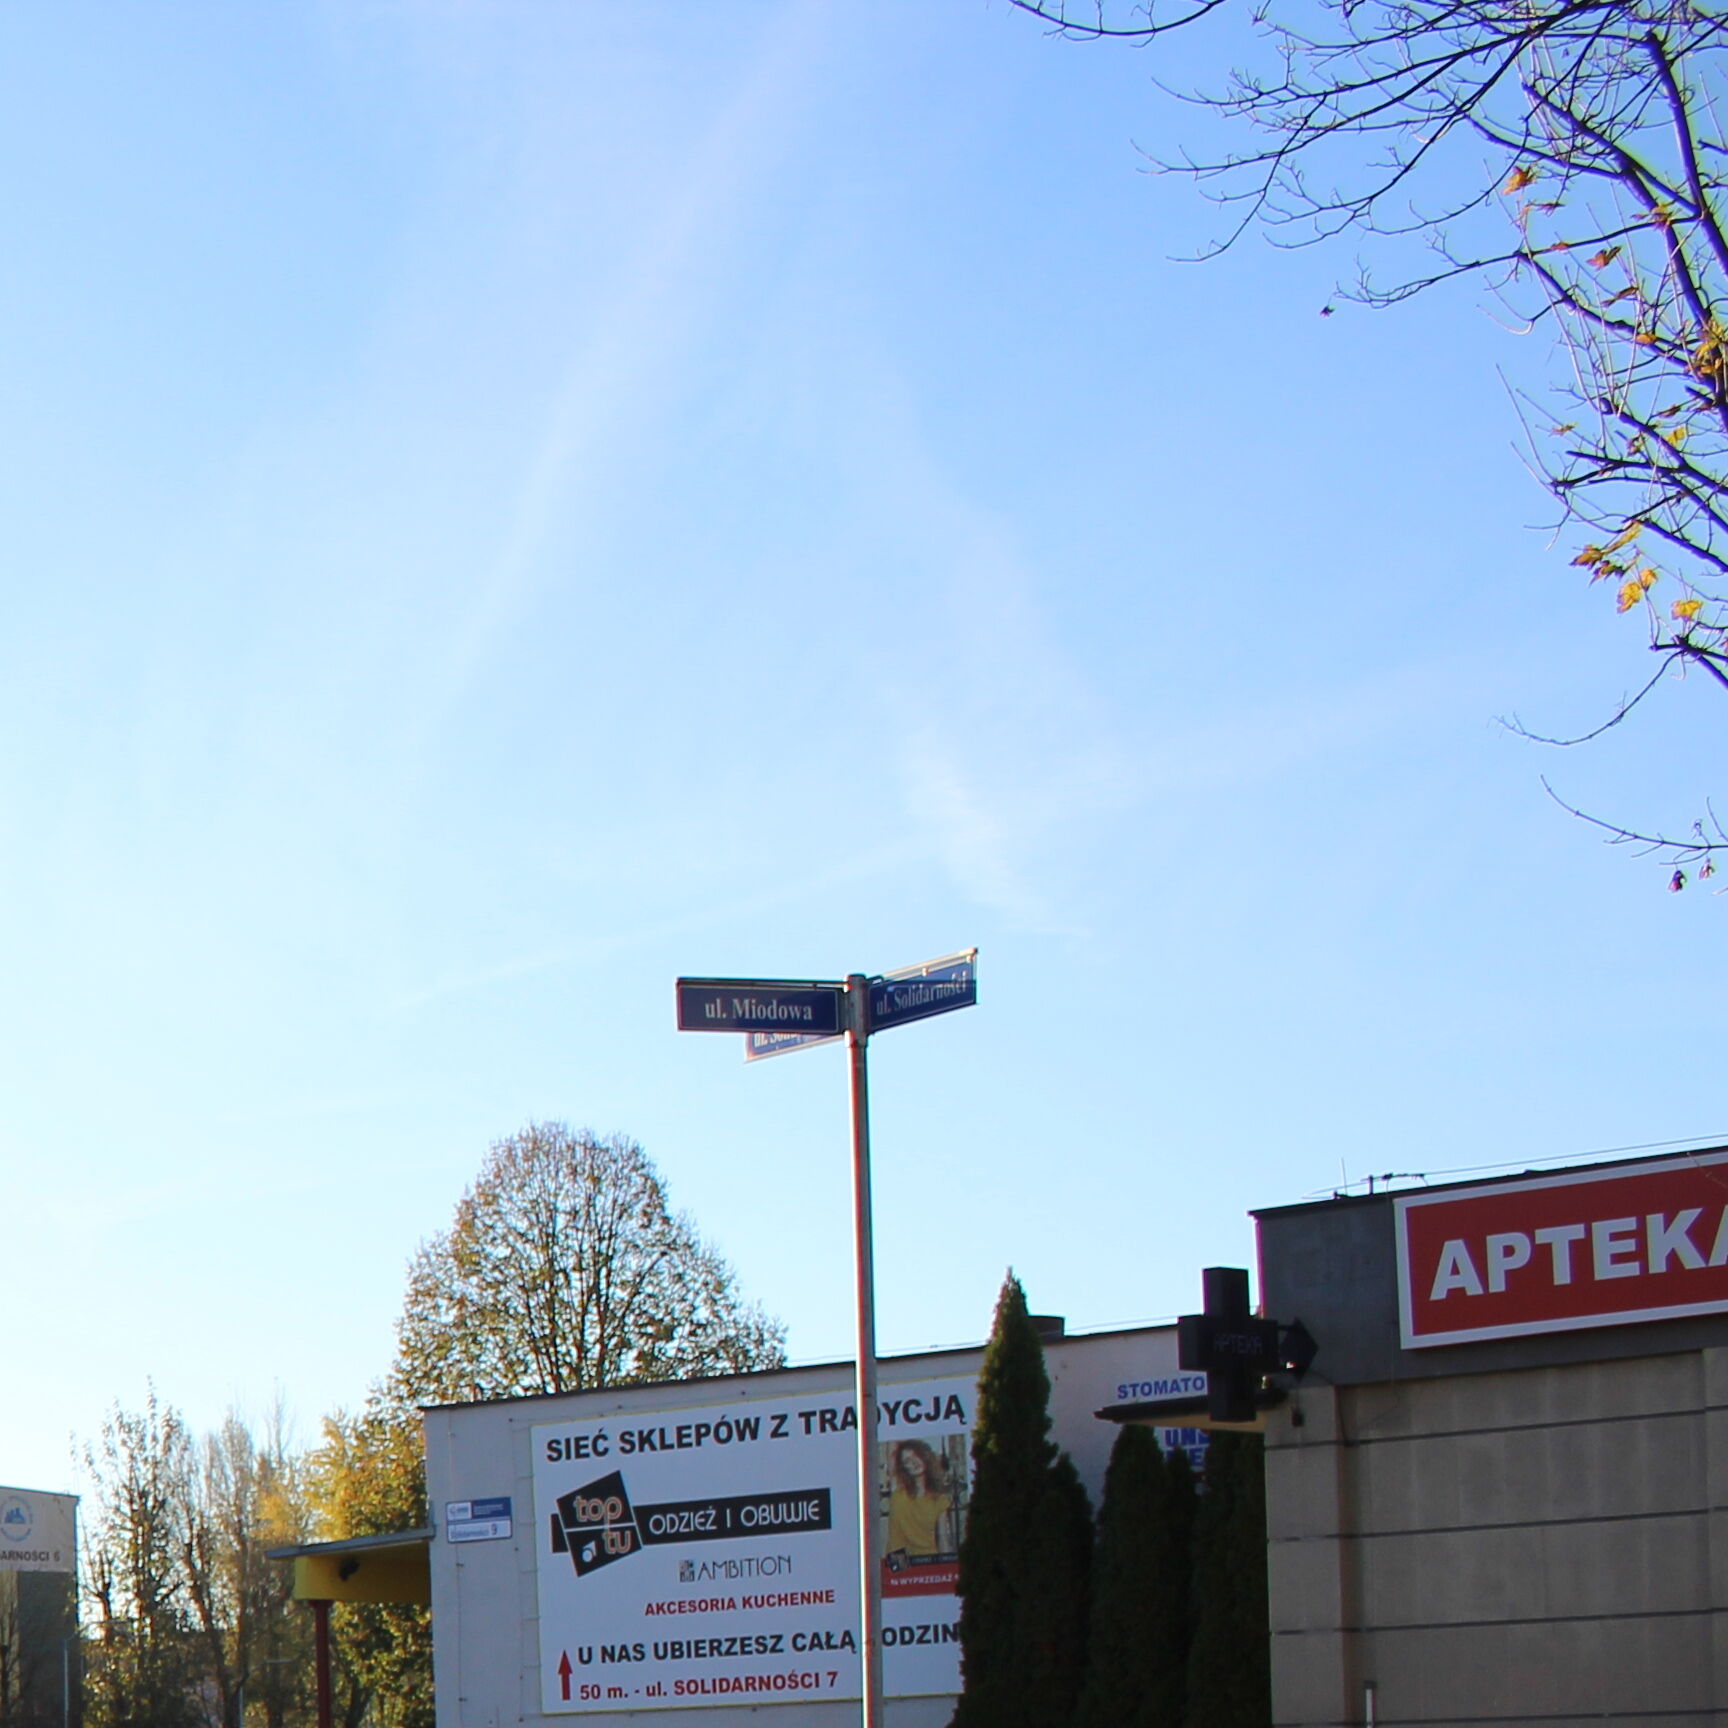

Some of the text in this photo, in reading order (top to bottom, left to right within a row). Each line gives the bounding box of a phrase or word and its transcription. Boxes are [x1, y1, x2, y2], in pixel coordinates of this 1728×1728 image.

[877, 971, 967, 1015] ul. Solidarności
[704, 998, 813, 1020] ul. Miodowa
[1117, 1376, 1206, 1399] STOMATO
[547, 1394, 968, 1462] SIEĆ SKLEPÓW Z TRAYCJĄ
[572, 1494, 622, 1528] top
[648, 1499, 820, 1536] ODZIEŻ I OBUWIE
[602, 1526, 632, 1554] tu
[697, 1555, 792, 1582] AMBITION
[645, 1589, 836, 1616] AKCESORIA KUCHENNE
[577, 1622, 961, 1665] U NAS UBIERZESZ CAŁĄ ODZIN
[580, 1684, 601, 1700] 50
[607, 1686, 629, 1699] m.
[646, 1680, 668, 1697] ul.
[674, 1669, 820, 1696] SOLIDARNOŚCI
[826, 1671, 839, 1688] 7
